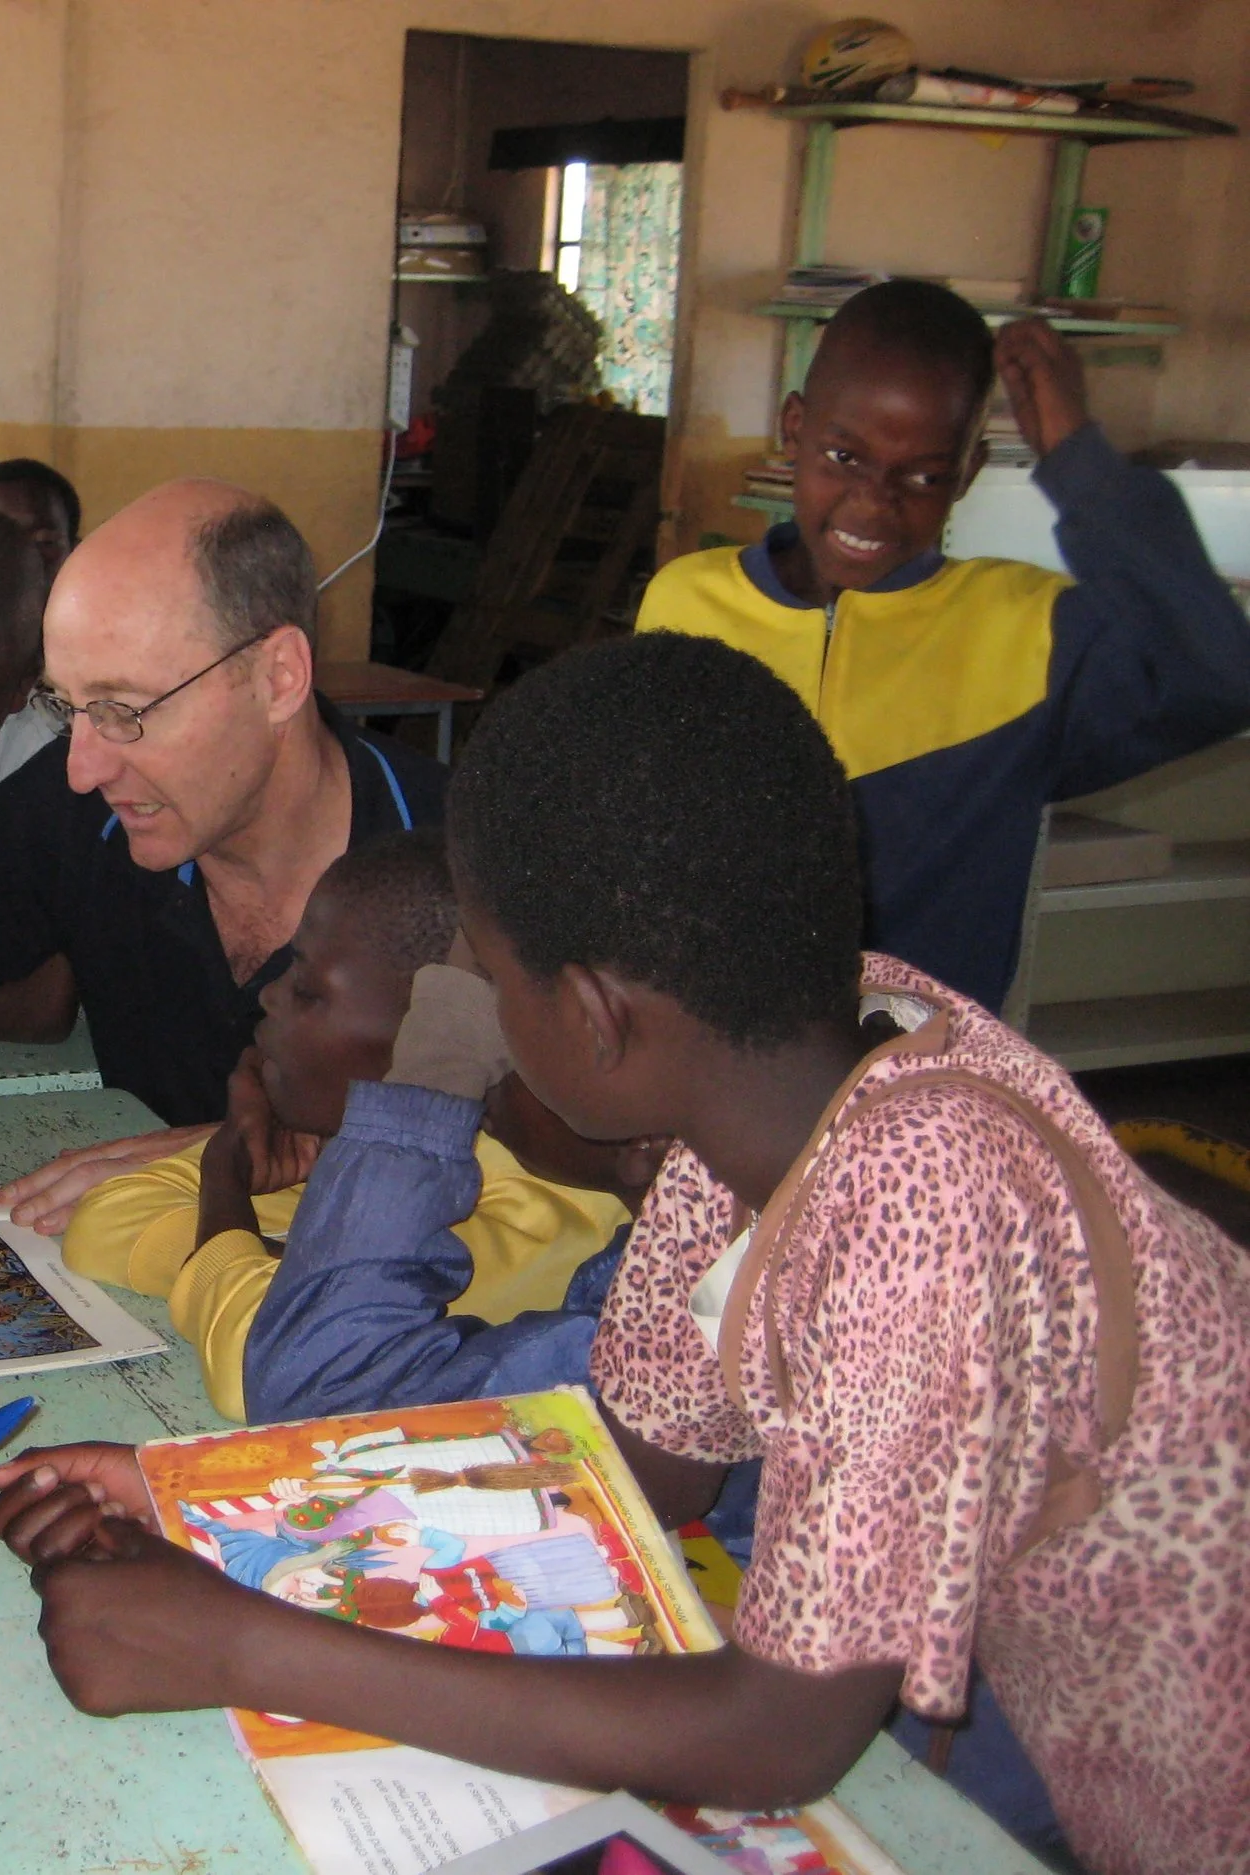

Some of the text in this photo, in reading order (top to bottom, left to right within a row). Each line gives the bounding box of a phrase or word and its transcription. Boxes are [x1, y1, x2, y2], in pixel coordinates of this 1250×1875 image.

[652, 1566, 667, 1582] the
[662, 1582, 678, 1601] was
[672, 1602, 689, 1625] Who
[427, 1807, 443, 1825] she
